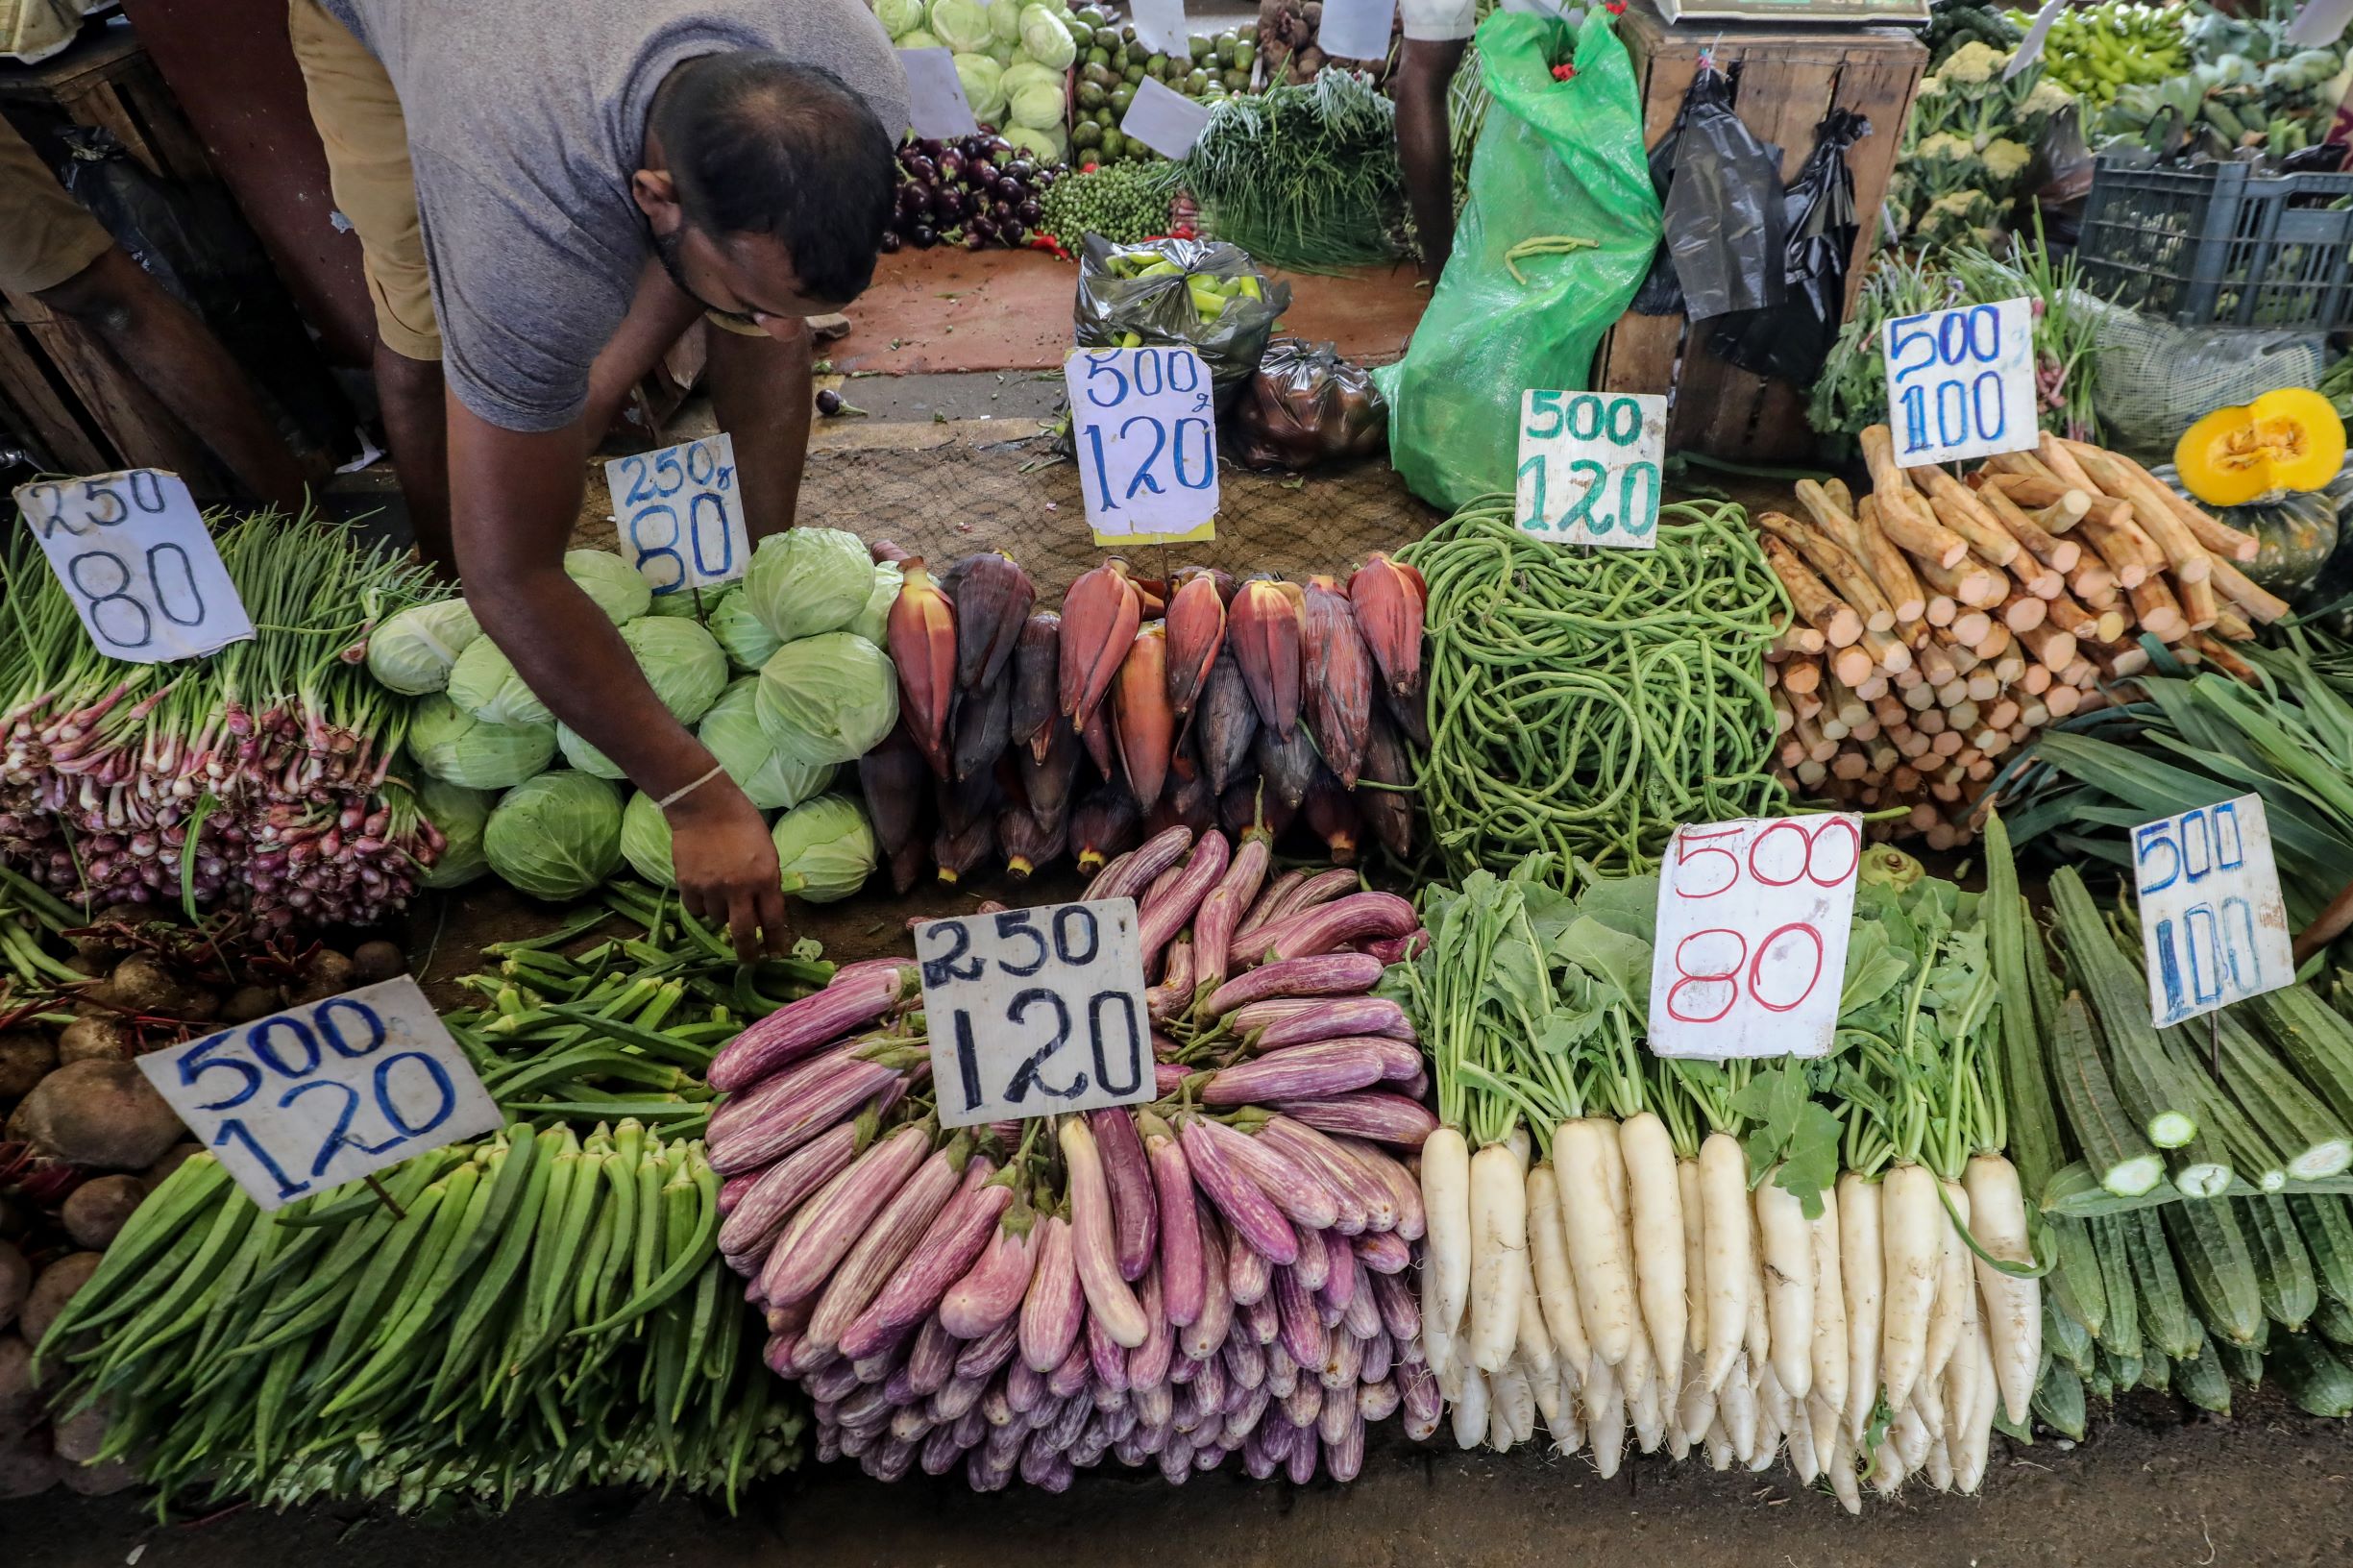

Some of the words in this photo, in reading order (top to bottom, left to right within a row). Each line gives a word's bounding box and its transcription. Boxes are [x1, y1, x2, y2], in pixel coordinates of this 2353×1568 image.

[1526, 390, 1643, 447] 500
[1899, 371, 2005, 453] 100
[30, 470, 165, 539] 250
[1084, 416, 1213, 512] 120
[1518, 454, 1661, 535] 120
[68, 542, 205, 648] 80
[1676, 817, 1860, 898] 500
[2138, 803, 2243, 895] 500
[922, 904, 1099, 990] 250
[1667, 922, 1823, 1022] 80
[2156, 895, 2261, 1023] 100
[176, 997, 386, 1111] 500
[954, 988, 1141, 1111] 120
[213, 1051, 455, 1199] 120
